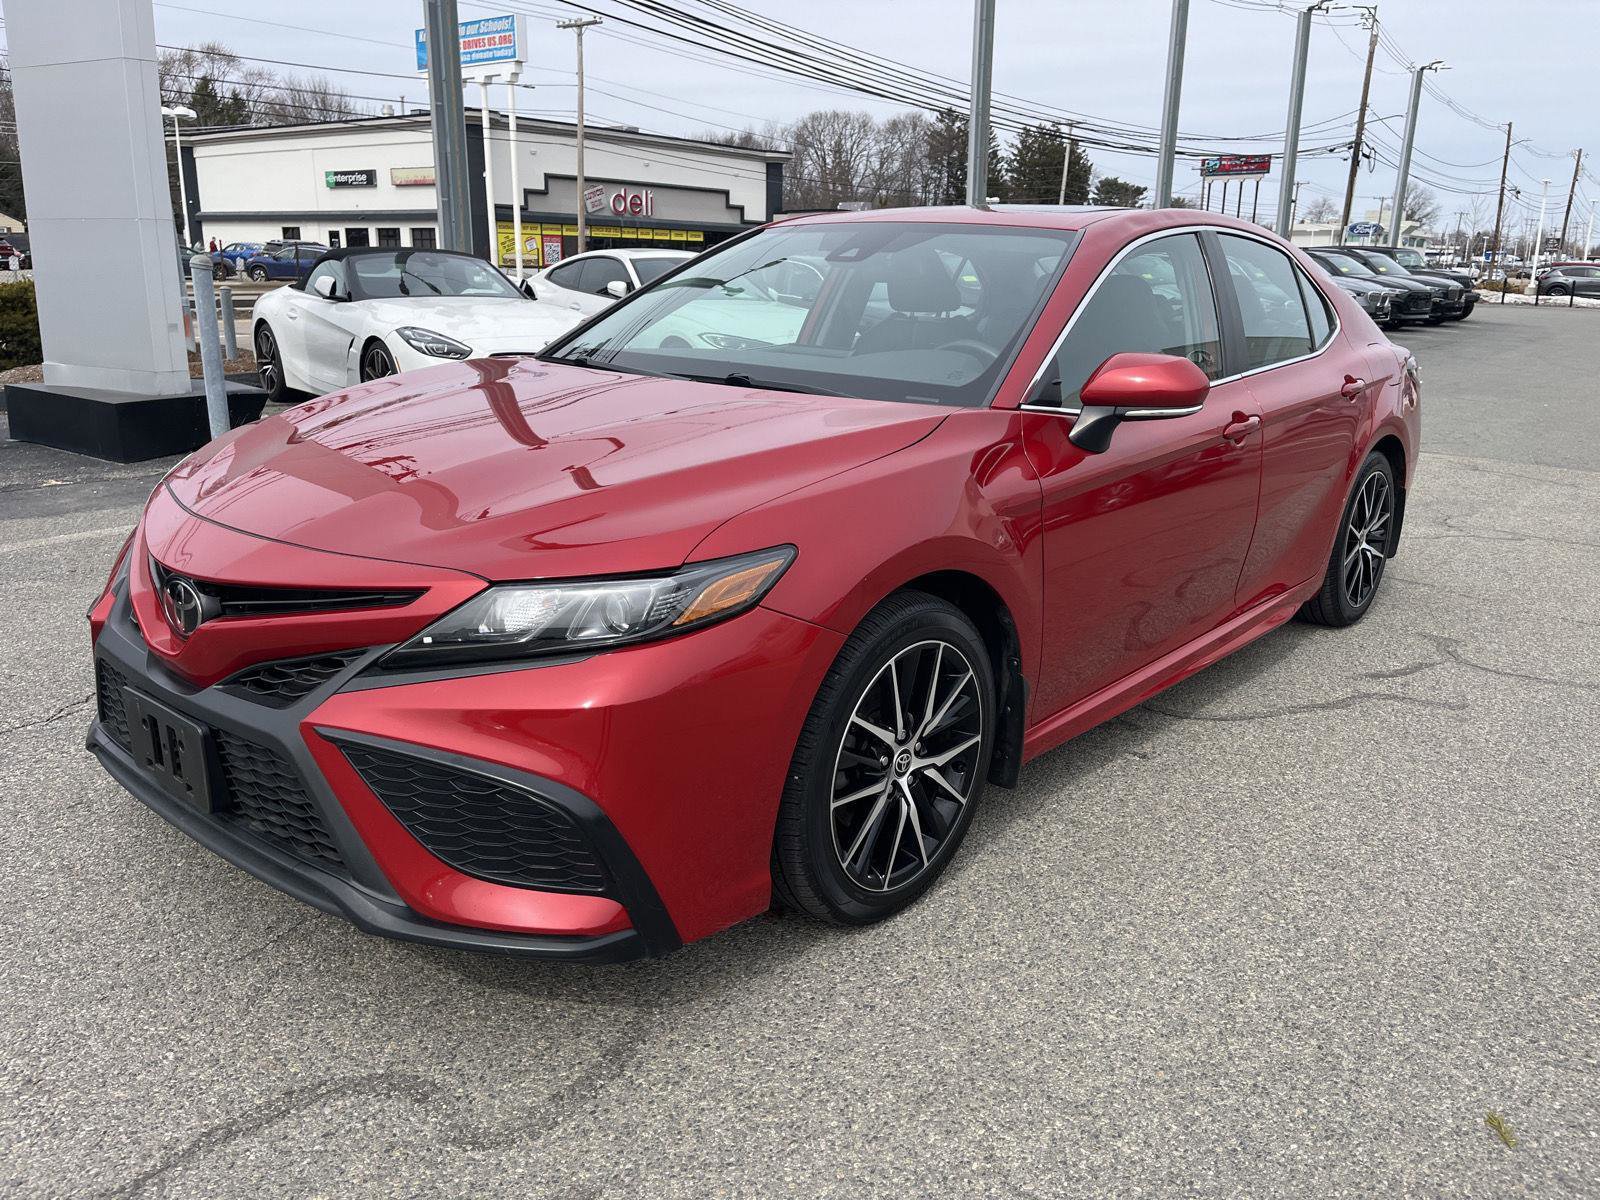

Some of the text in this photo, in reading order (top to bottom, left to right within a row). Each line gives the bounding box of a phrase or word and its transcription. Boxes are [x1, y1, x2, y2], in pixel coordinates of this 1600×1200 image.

[479, 17, 512, 34] Schools!
[463, 37, 486, 50] DRIVES
[326, 172, 367, 185] enterprise
[609, 187, 654, 217] deli
[1353, 224, 1377, 234] Ford
